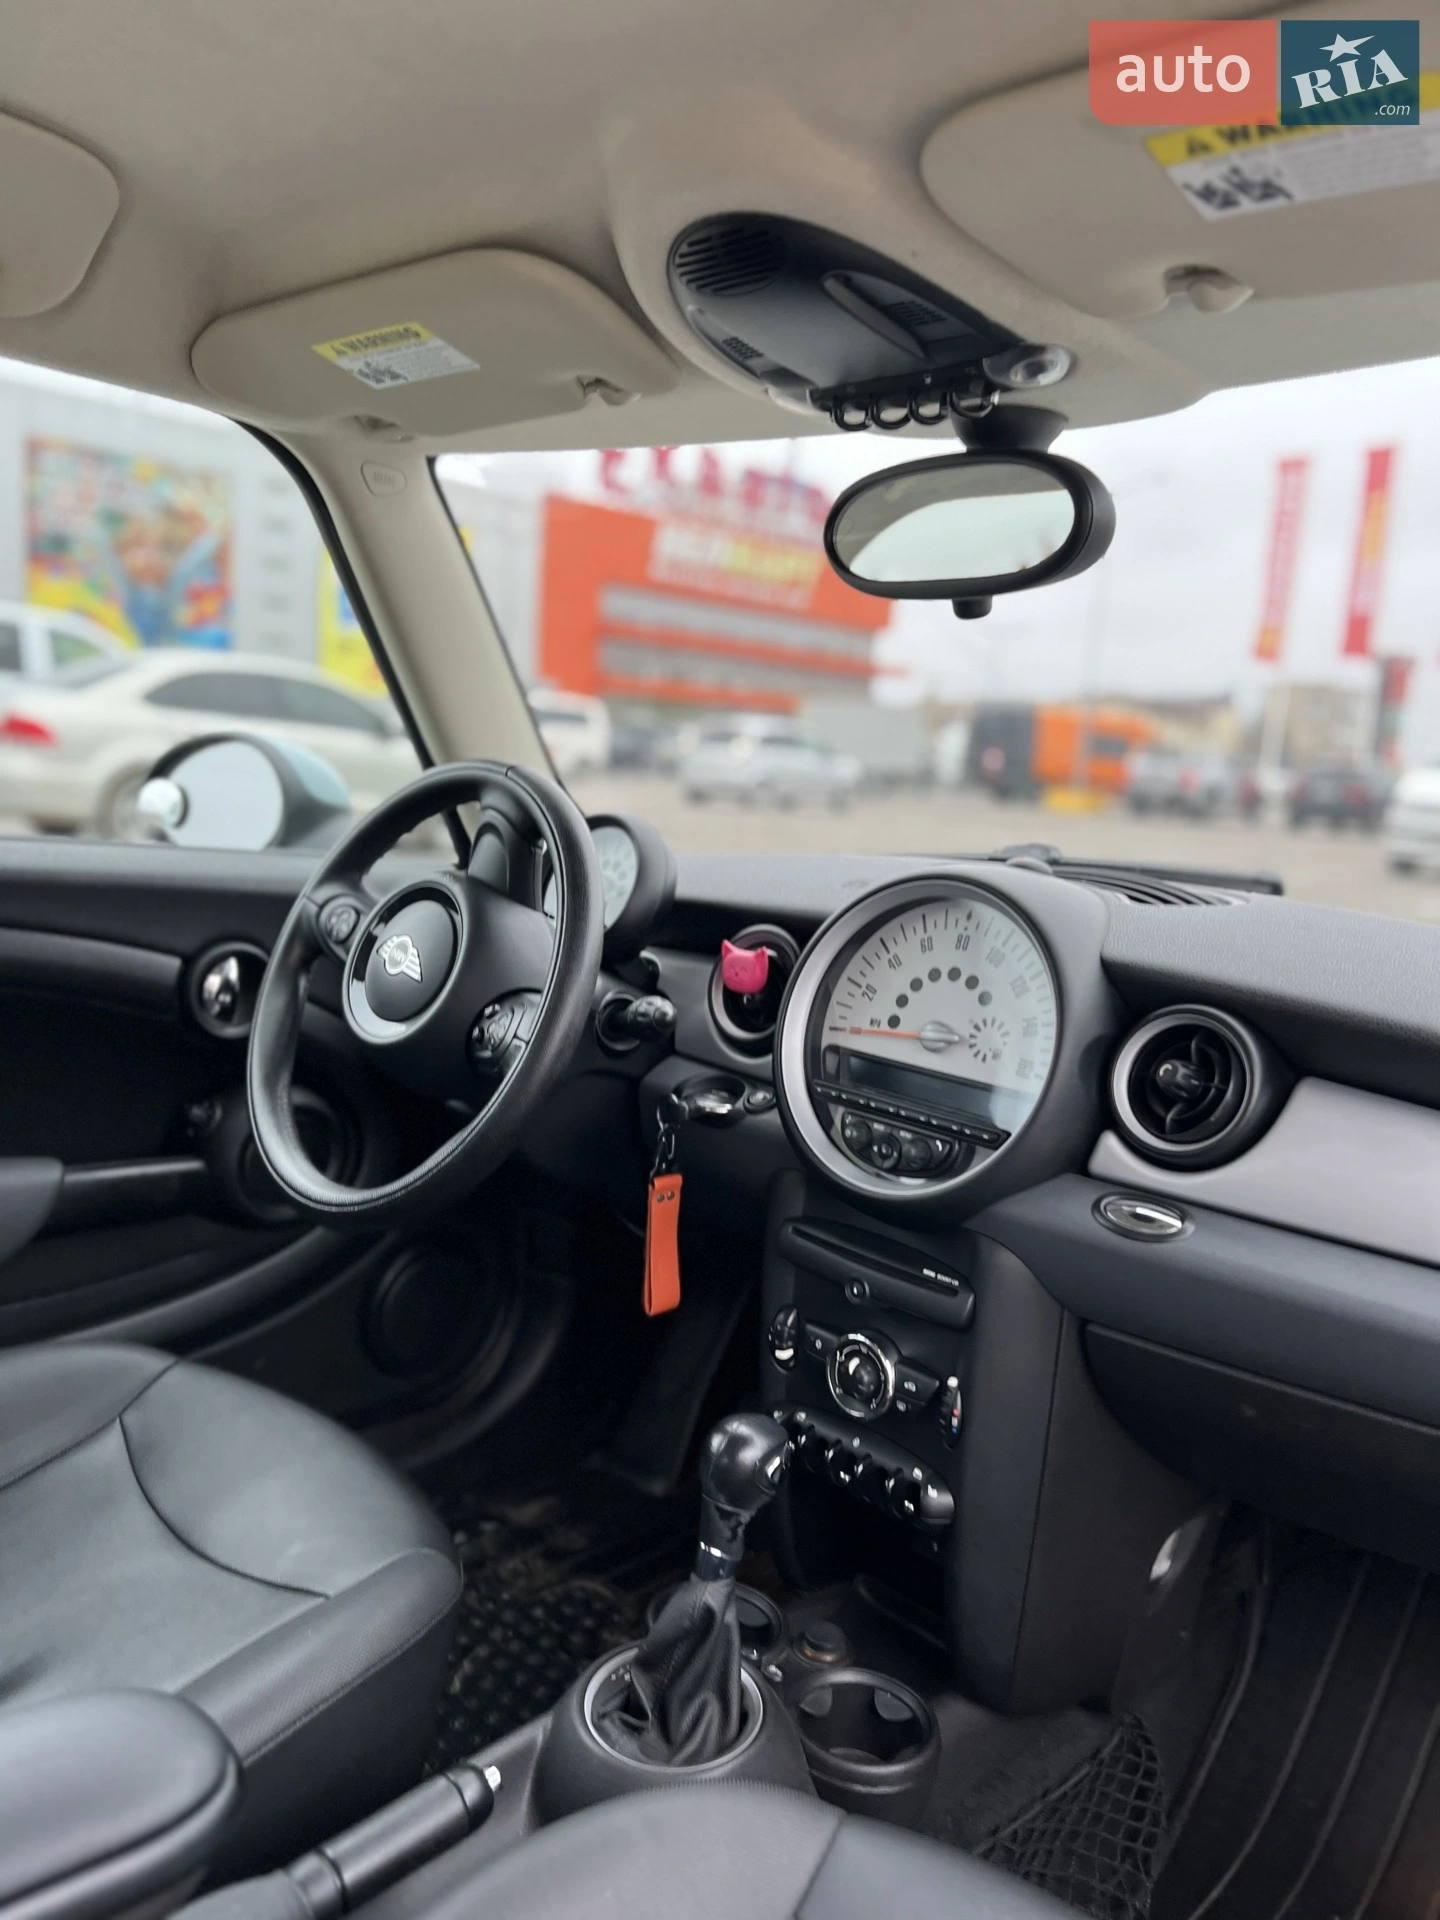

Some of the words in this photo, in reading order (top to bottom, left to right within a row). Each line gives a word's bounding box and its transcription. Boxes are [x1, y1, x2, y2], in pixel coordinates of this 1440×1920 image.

[920, 936, 934, 953] 60
[955, 934, 970, 952] 80
[887, 953, 903, 972] 40
[861, 983, 877, 1002] 20
